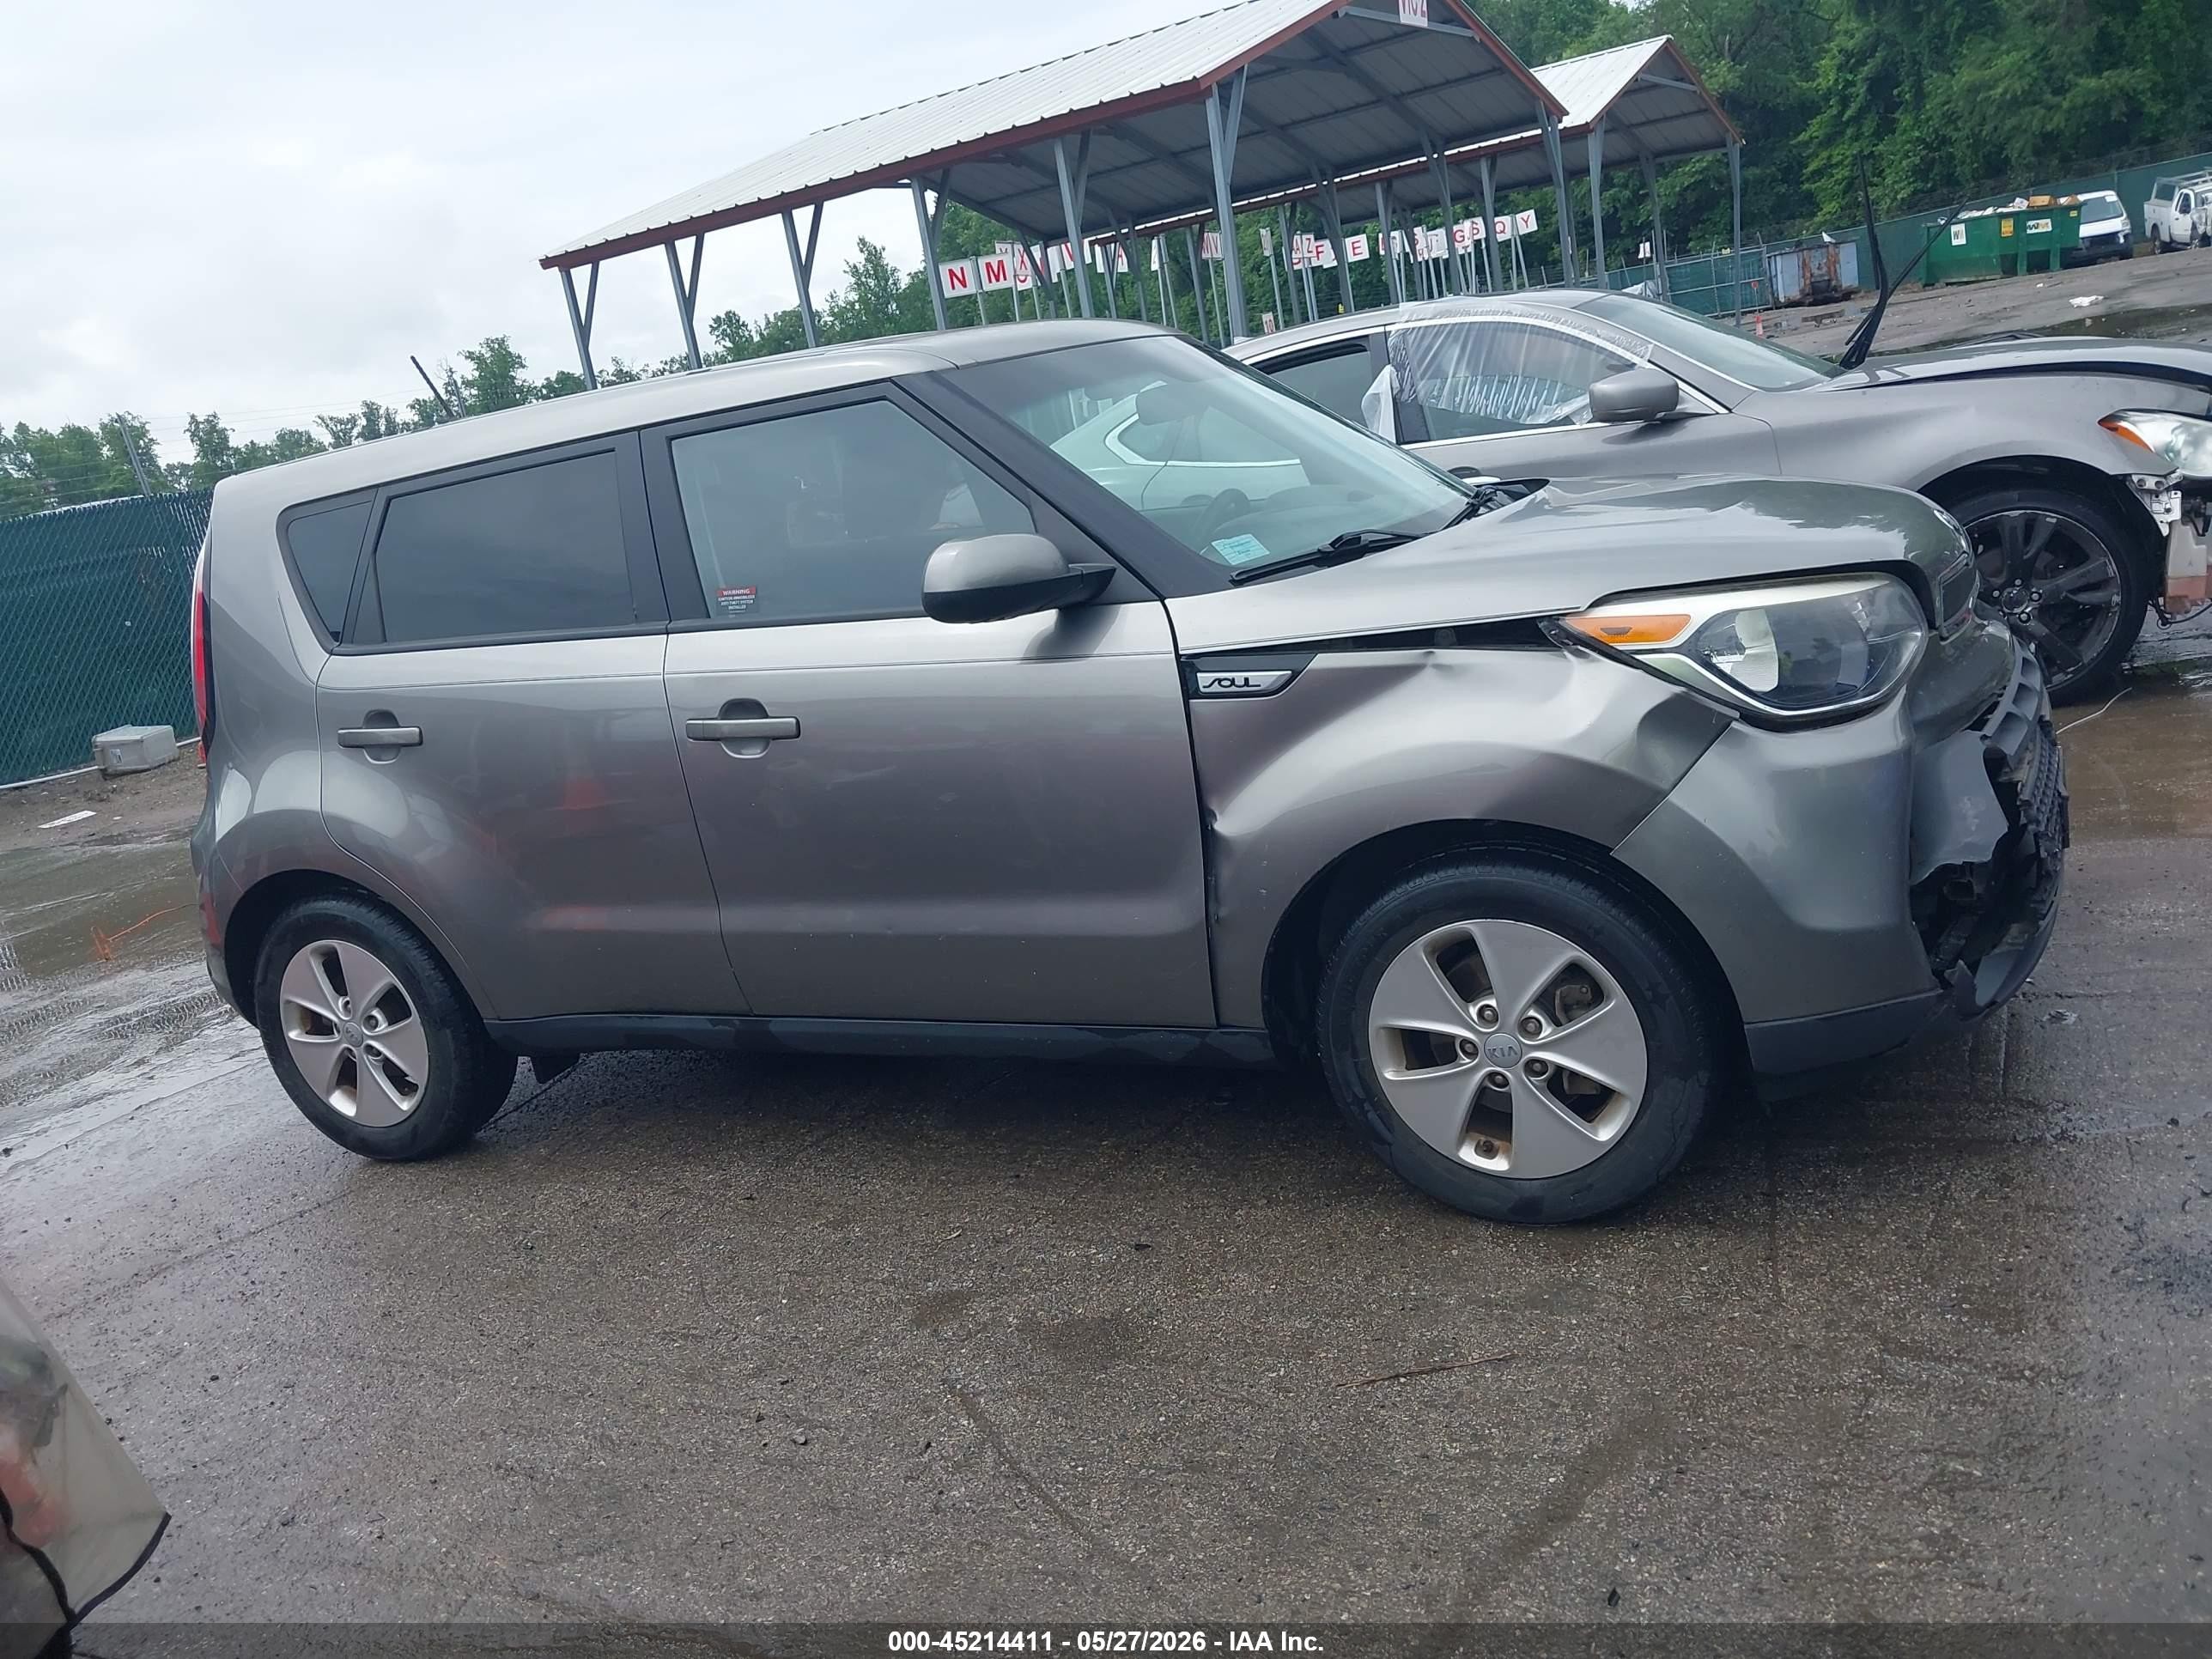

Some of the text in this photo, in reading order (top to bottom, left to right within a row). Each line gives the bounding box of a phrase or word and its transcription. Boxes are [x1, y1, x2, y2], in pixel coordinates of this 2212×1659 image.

[1494, 221, 1506, 235] Q
[1521, 215, 1530, 229] Y
[1454, 229, 1465, 244] G
[1305, 238, 1314, 253] Z
[1315, 244, 1325, 261] F
[1352, 240, 1363, 257] E
[1018, 248, 1028, 270] X
[947, 266, 968, 290] N
[985, 259, 1007, 284] M
[1202, 678, 1261, 688] SOUL
[1487, 1045, 1517, 1058] KIA
